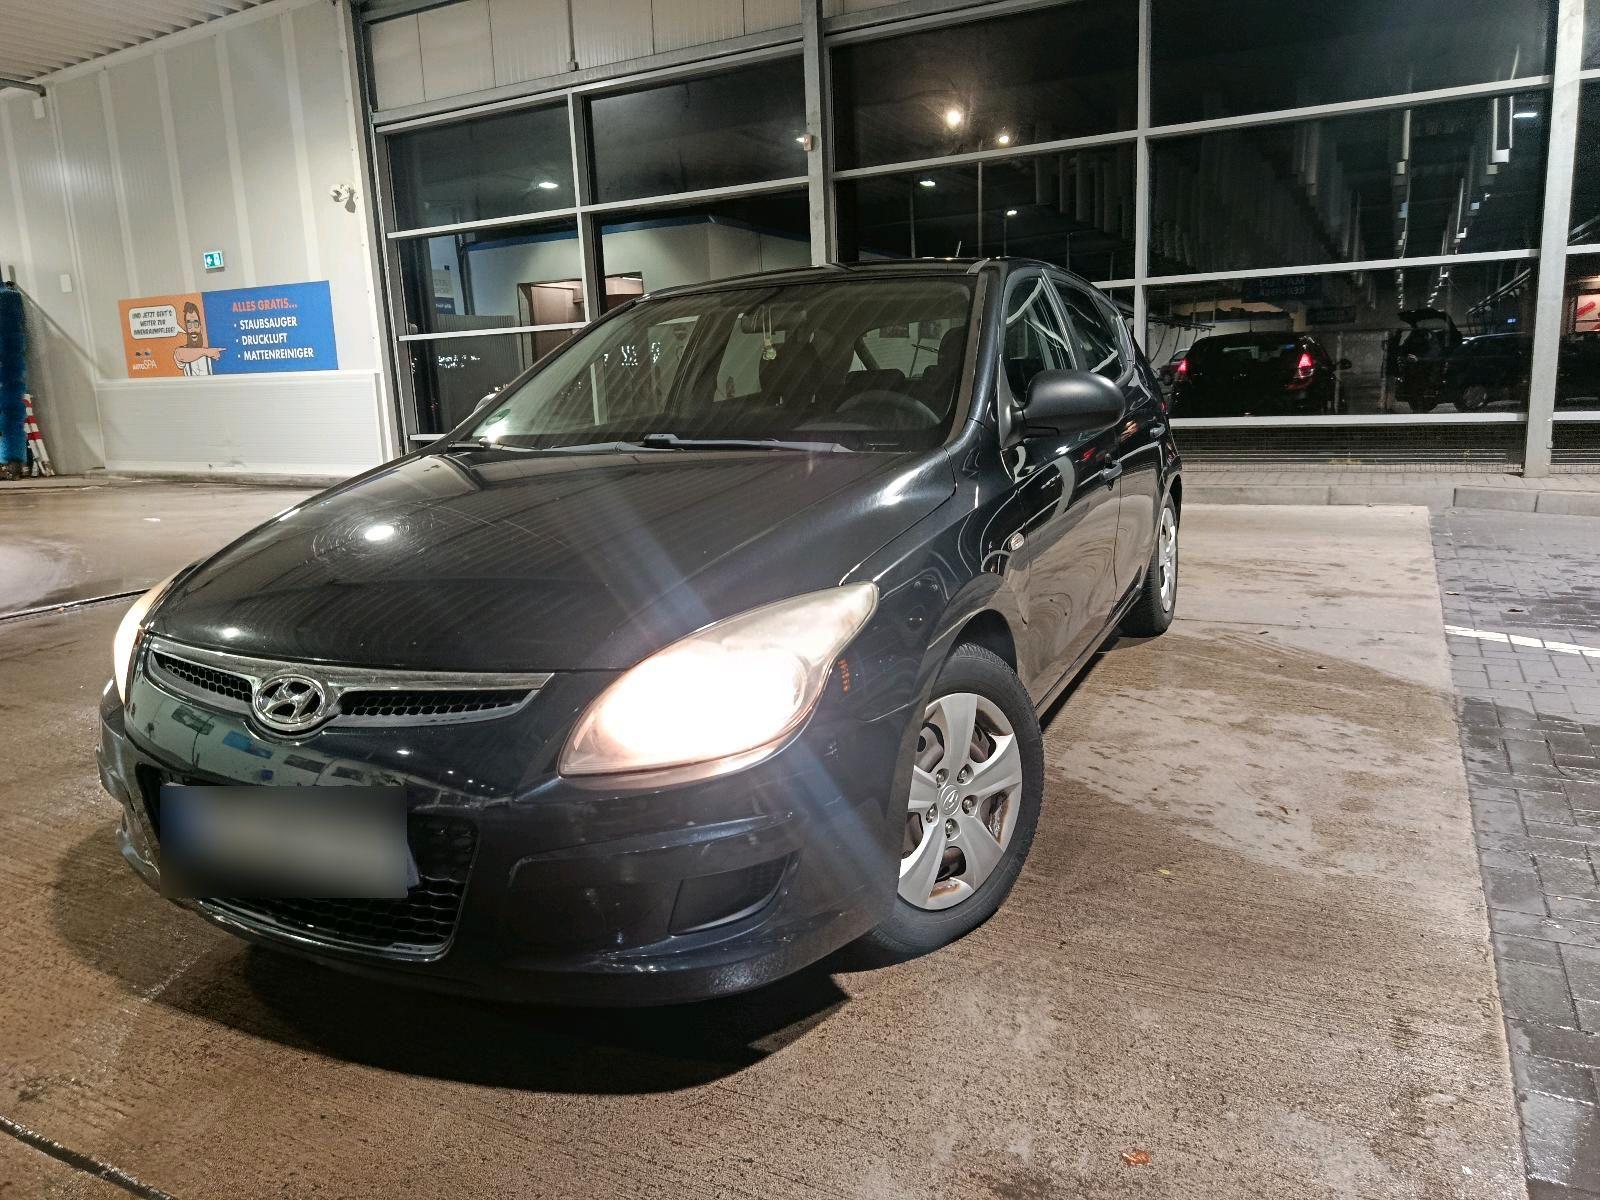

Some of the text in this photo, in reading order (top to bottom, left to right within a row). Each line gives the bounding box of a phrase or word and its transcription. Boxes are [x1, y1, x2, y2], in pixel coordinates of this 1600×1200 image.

[232, 301, 256, 312] ALLES
[240, 316, 298, 330] STAUBSAUGER
[241, 333, 288, 345] DRUCKLUFT
[243, 347, 314, 360] MATTENREINIGER
